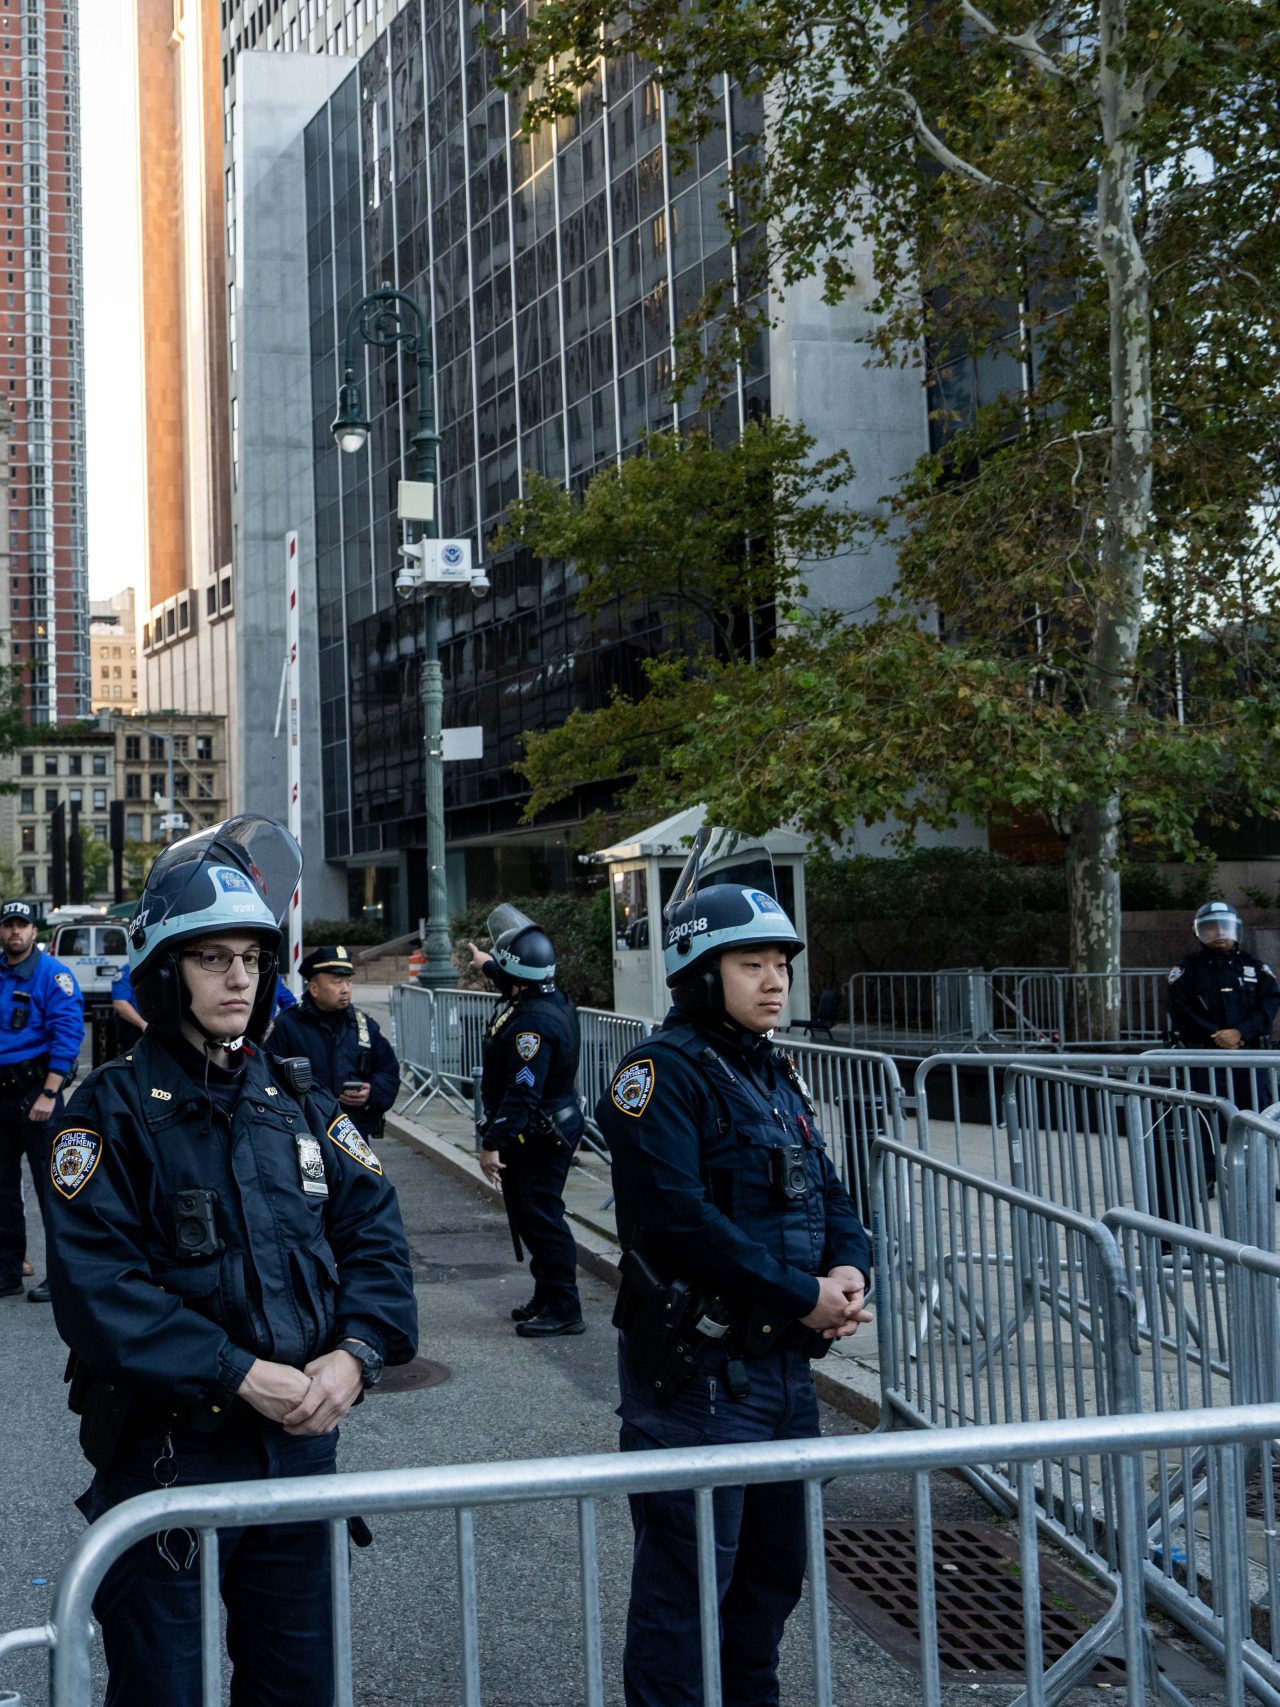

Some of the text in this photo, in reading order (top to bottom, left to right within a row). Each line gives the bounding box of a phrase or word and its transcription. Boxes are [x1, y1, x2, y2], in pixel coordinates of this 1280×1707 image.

[3, 902, 31, 915] NYPD
[669, 917, 708, 944] 23038
[151, 1088, 172, 1101] 109
[61, 1132, 87, 1141] POLICE
[55, 1140, 97, 1154] DEPARTMENT
[72, 1154, 97, 1189] NEW YORK
